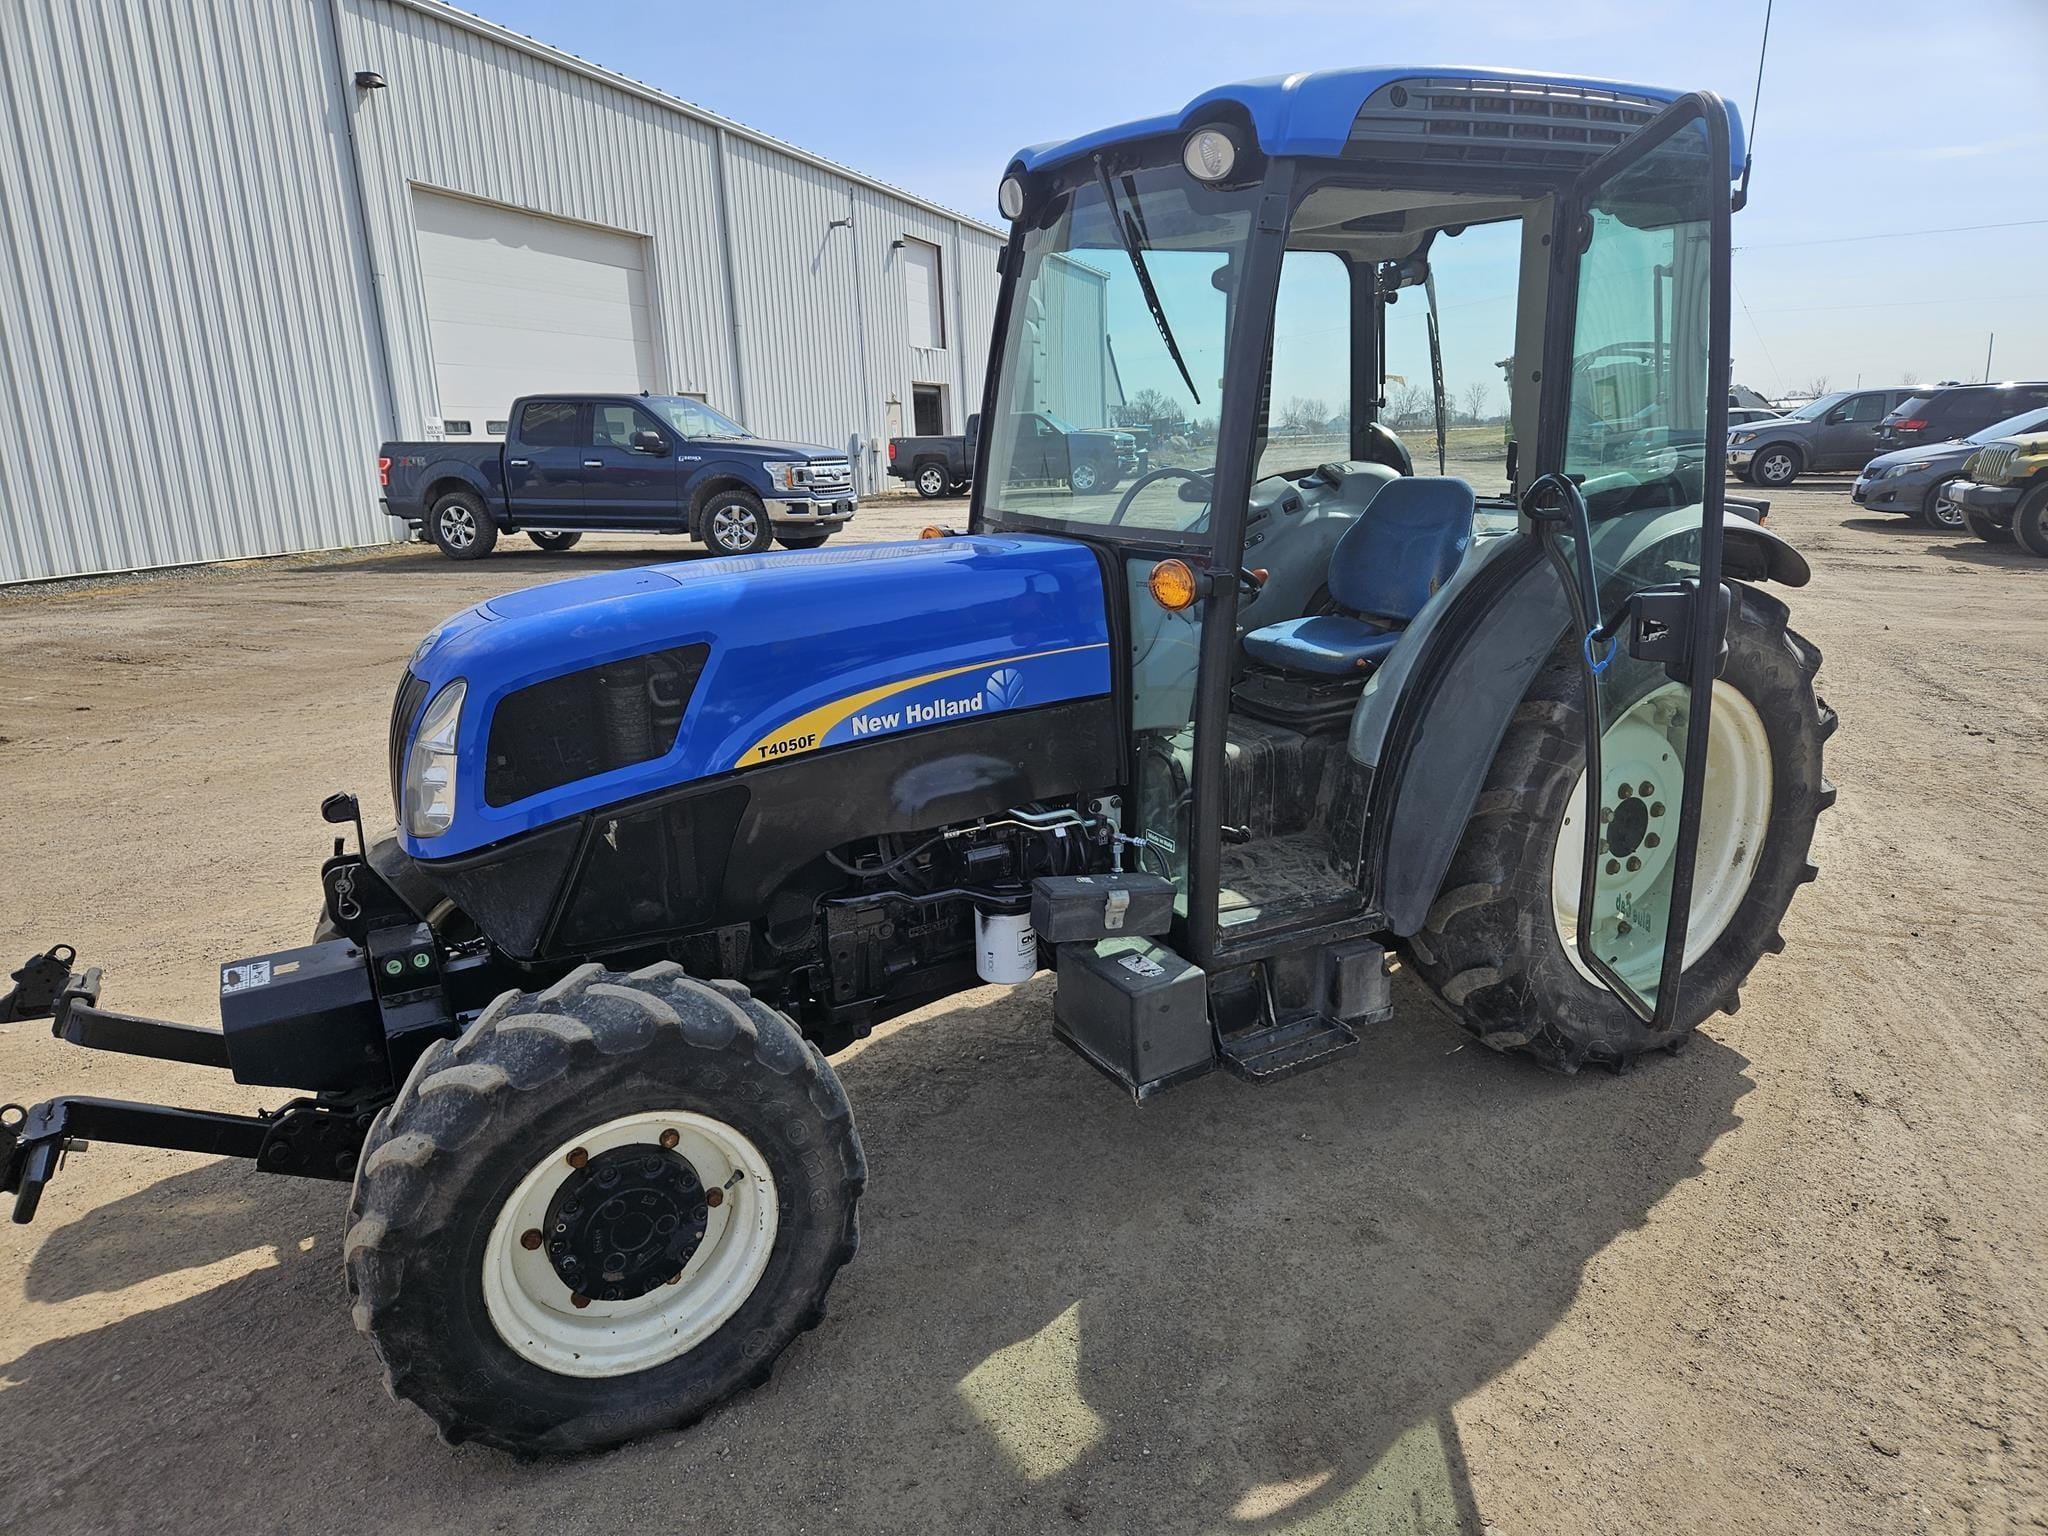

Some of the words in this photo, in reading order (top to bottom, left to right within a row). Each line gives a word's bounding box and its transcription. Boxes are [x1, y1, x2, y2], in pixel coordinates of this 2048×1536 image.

[851, 711, 900, 736] New
[905, 692, 983, 725] Holland
[757, 734, 817, 760] T4050F
